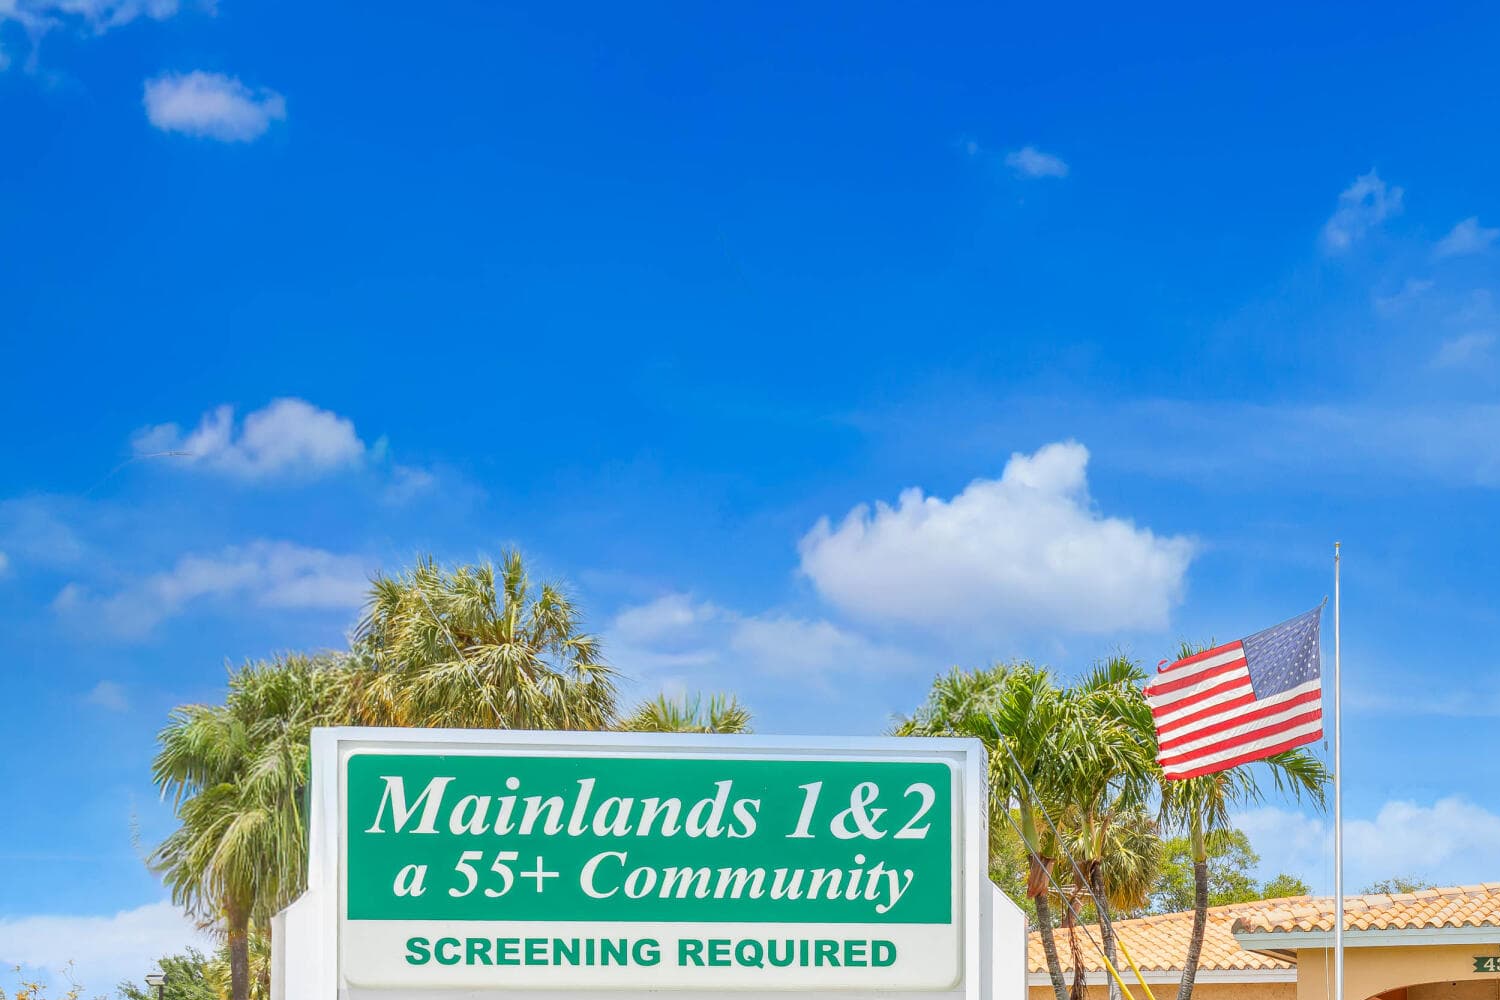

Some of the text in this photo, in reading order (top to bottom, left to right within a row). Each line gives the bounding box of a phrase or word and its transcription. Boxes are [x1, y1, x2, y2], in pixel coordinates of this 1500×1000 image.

[364, 775, 936, 840] Mainlands 1&2
[393, 850, 914, 914] a 55+ Community
[404, 936, 897, 969] SCREENING REQUIRED
